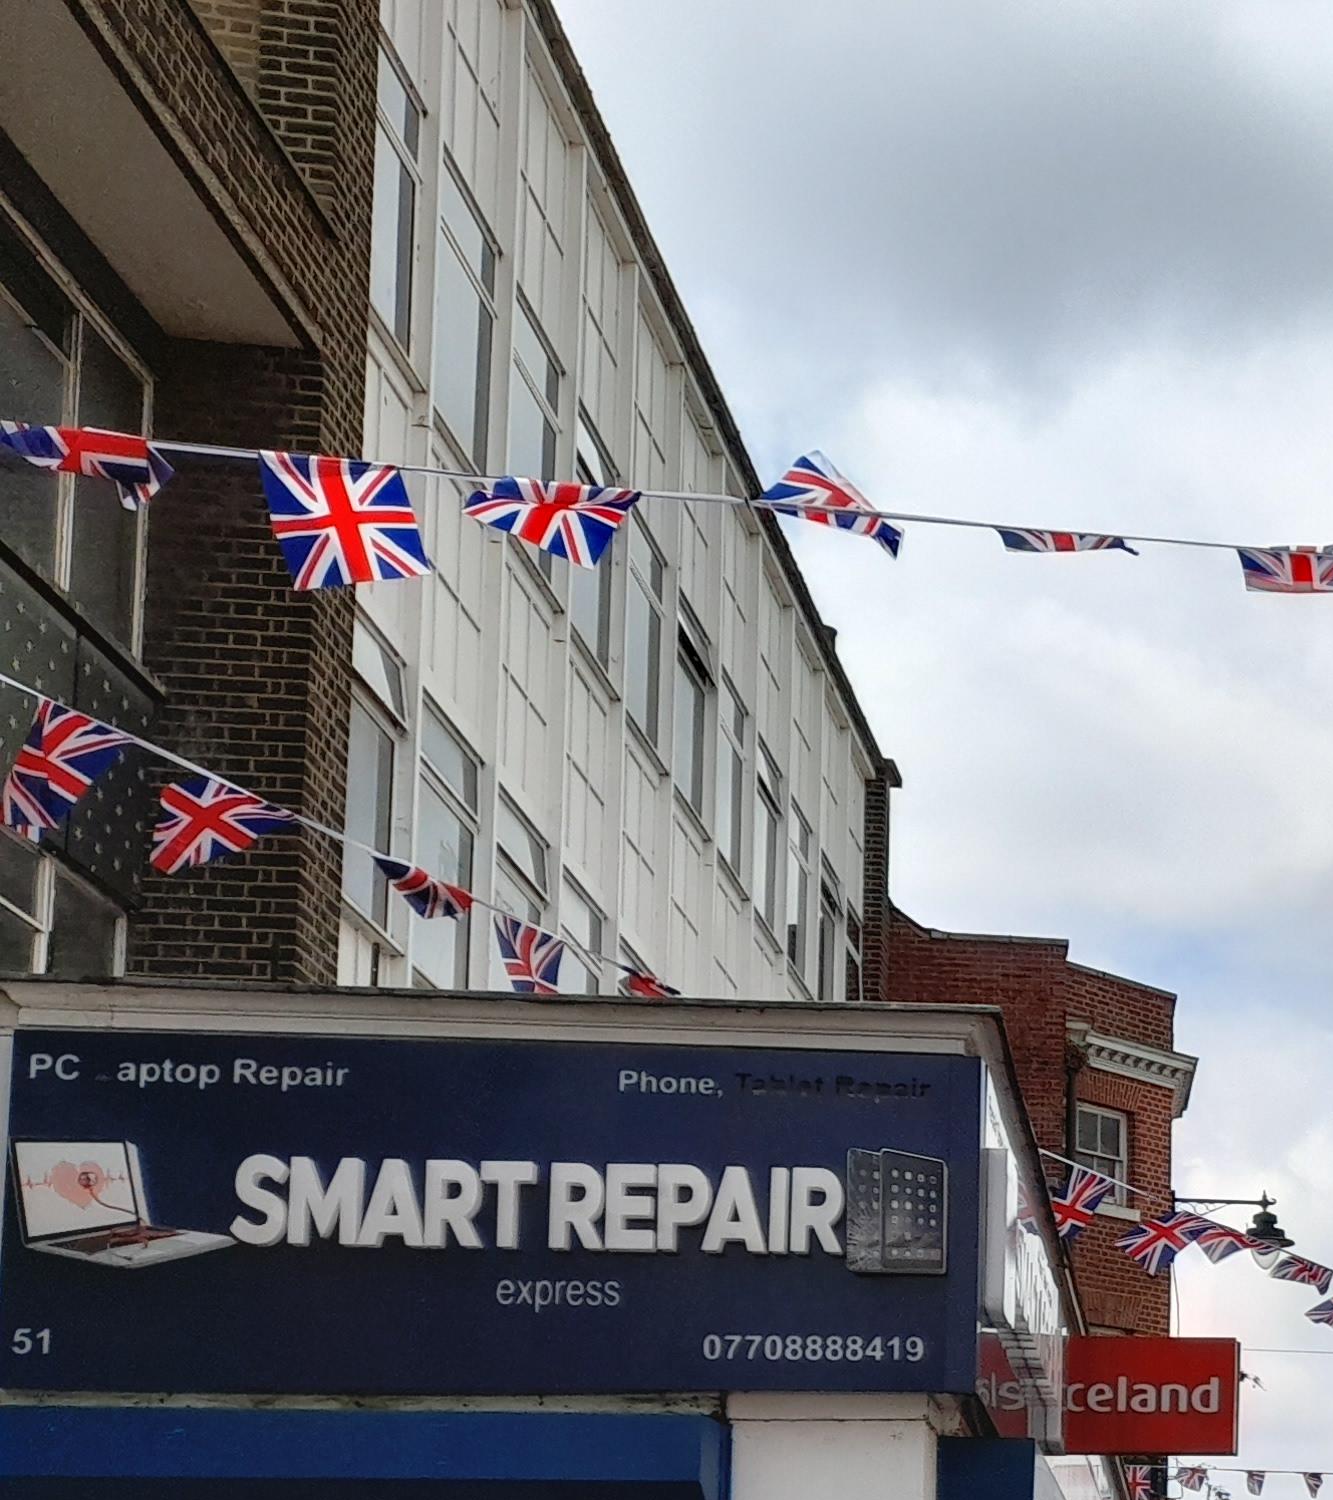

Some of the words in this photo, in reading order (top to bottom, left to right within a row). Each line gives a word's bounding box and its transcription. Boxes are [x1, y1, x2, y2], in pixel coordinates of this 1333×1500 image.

[28, 1053, 81, 1080] PC
[232, 1058, 349, 1091] Repair
[618, 1070, 724, 1098] Phone,
[231, 1152, 542, 1252] SMART
[546, 1162, 846, 1257] REPAIR
[495, 1274, 621, 1311] express
[11, 1327, 52, 1357] 51
[702, 1334, 925, 1363] 07708888419
[1065, 1376, 1220, 1413] celand
